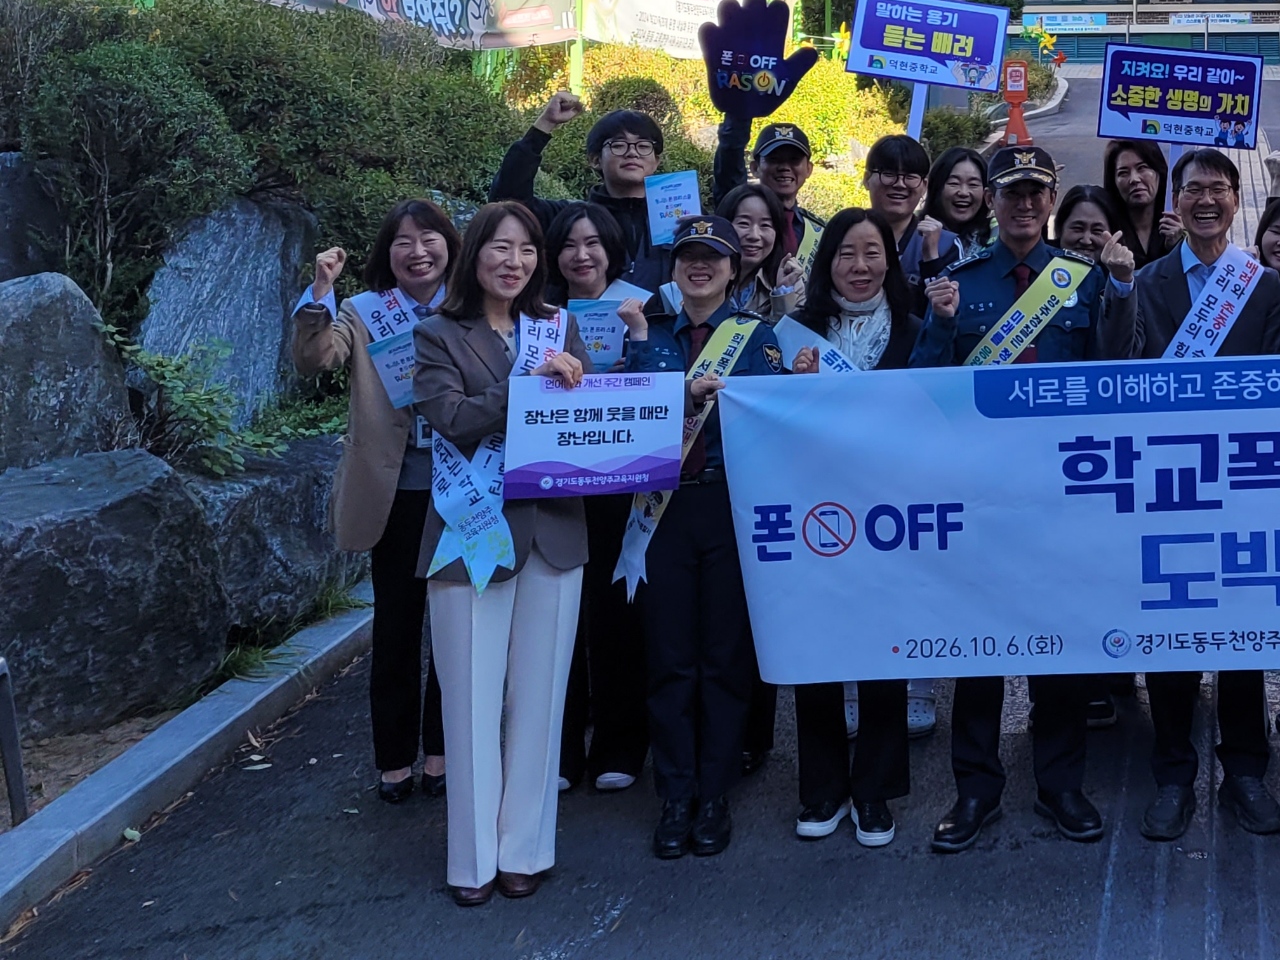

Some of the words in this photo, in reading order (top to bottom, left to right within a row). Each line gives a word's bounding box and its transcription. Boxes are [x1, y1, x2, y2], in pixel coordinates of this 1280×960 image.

[875, 2, 924, 24] 말하는
[926, 9, 959, 28] 용기
[883, 24, 926, 52] 듣는
[931, 30, 975, 58] 배려
[720, 49, 734, 65] 폰
[750, 54, 778, 69] OFF
[888, 58, 939, 75] 덕현중학교
[1120, 60, 1170, 80] 지켜요!
[1173, 64, 1203, 82] 우리
[1110, 85, 1162, 110] 소중한
[1166, 88, 1212, 112] 생명의
[1216, 94, 1250, 116] 가치
[1163, 123, 1215, 138] 덕현중학교
[1215, 264, 1236, 293] 우리
[1231, 260, 1259, 300] 배려와
[370, 310, 396, 338] 우리
[990, 309, 1025, 346] 미래를
[1010, 295, 1060, 350] 양주경찰은
[1184, 294, 1219, 340] 모두의
[1204, 300, 1236, 346] 존중이
[584, 377, 602, 388] 개선
[604, 377, 623, 387] 주간
[624, 376, 651, 387] 캠페인
[1008, 376, 1090, 408] 서로를
[1097, 372, 1206, 405] 이해하고
[524, 408, 570, 425] 장난은
[573, 407, 603, 423] 함께
[606, 406, 636, 422] 웃을
[639, 405, 669, 421] 때만
[557, 429, 635, 447] 장난입니다.
[555, 473, 650, 487] 경기도동두천양주교육지원청
[751, 503, 792, 563] 폰
[864, 502, 965, 552] OFF
